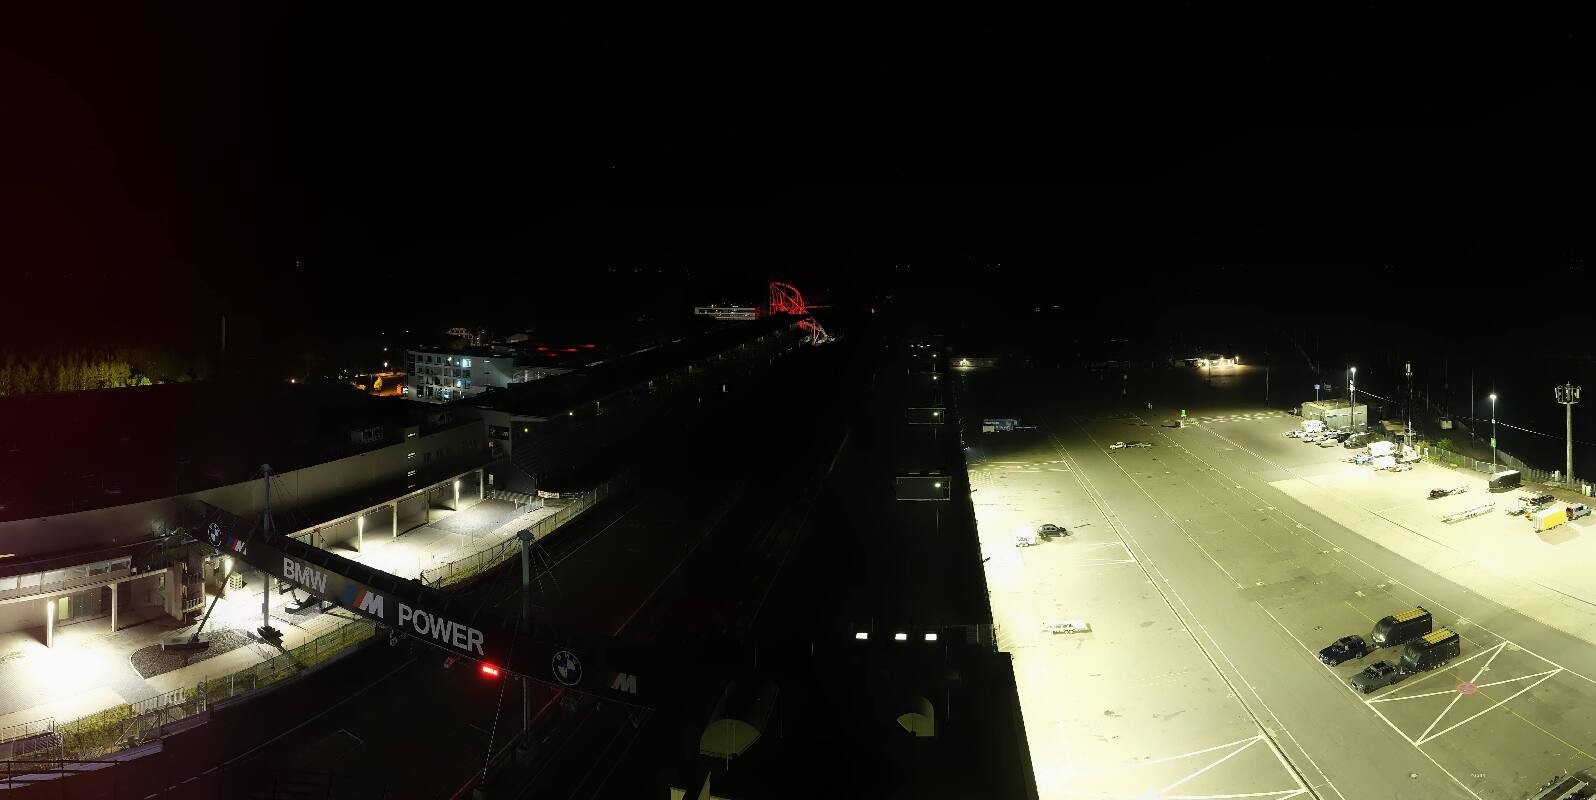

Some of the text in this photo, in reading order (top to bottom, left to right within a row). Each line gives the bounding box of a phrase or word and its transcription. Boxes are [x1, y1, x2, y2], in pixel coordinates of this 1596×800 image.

[284, 558, 485, 655] BMW M POWER
